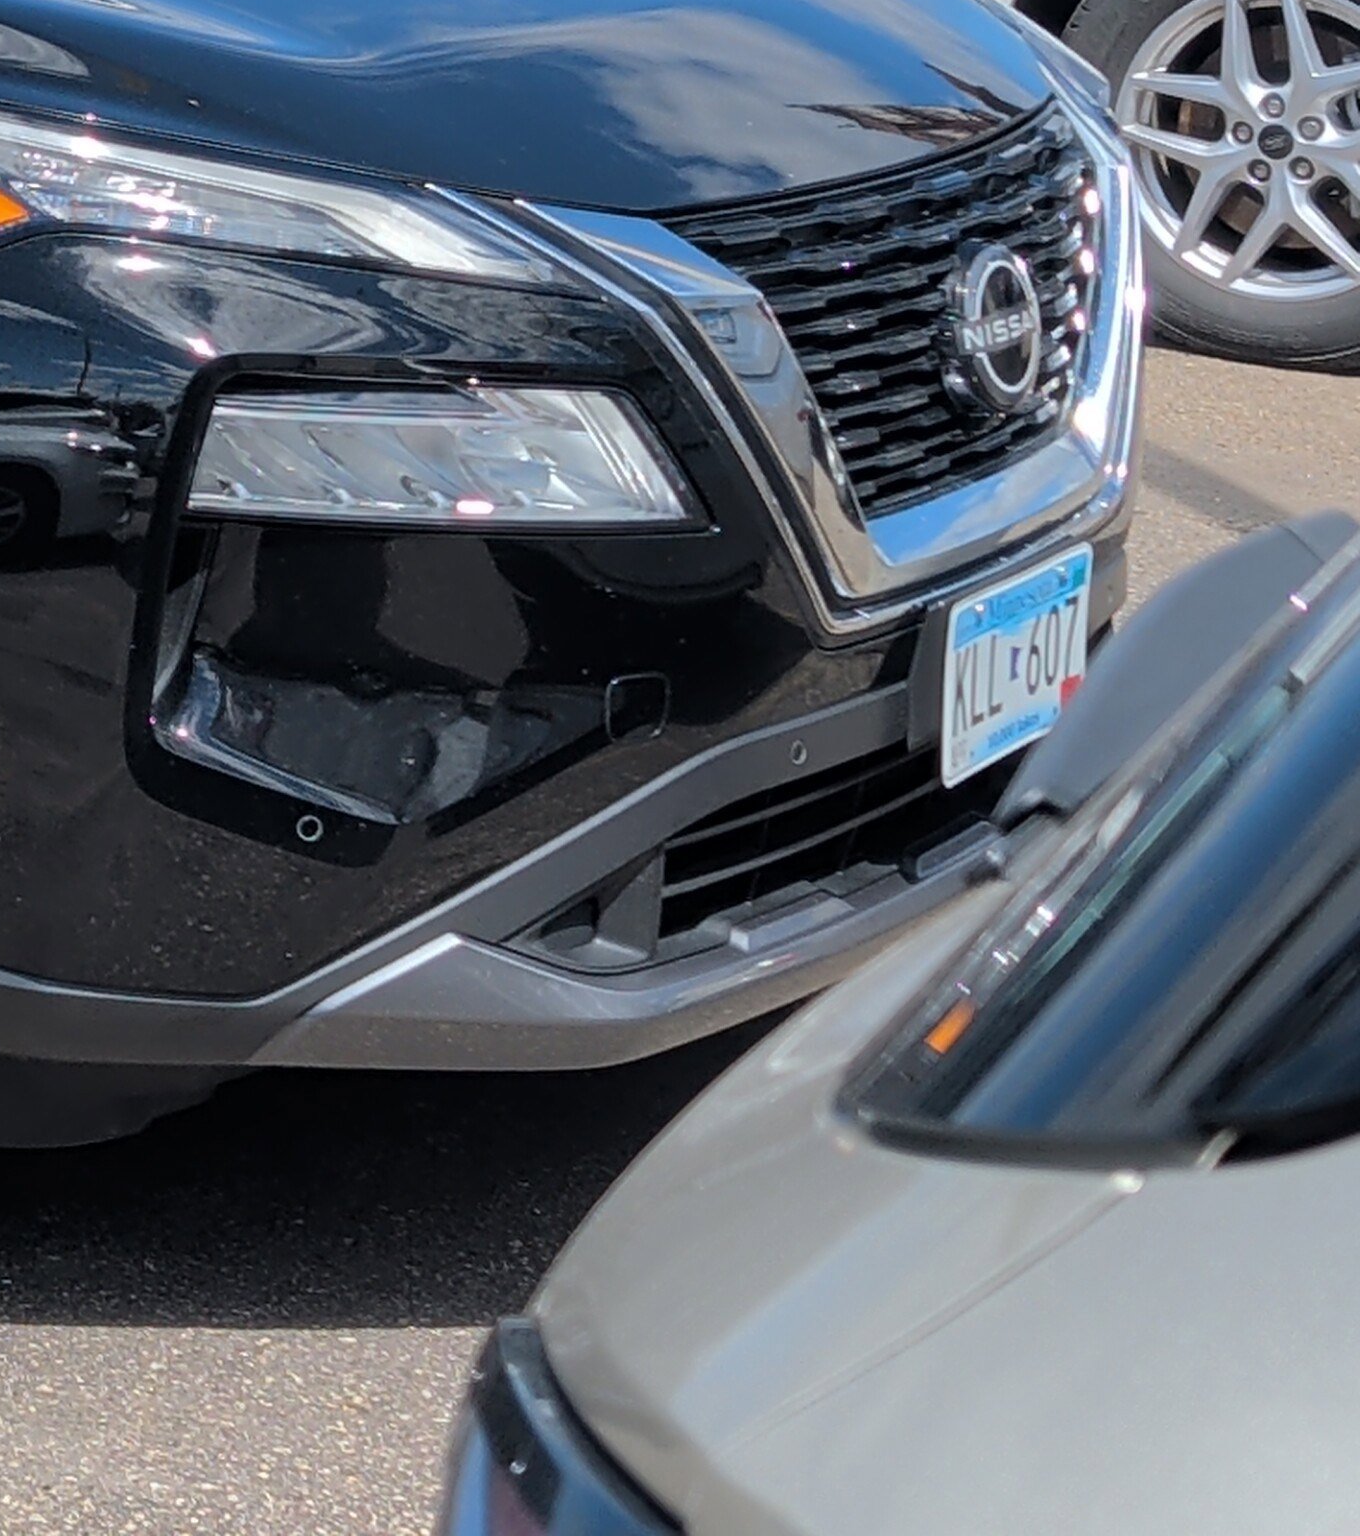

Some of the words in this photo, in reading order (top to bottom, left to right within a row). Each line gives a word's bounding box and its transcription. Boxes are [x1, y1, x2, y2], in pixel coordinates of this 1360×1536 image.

[962, 310, 1044, 350] NISSA
[953, 632, 1003, 737] KLL
[1026, 596, 1079, 695] 607
